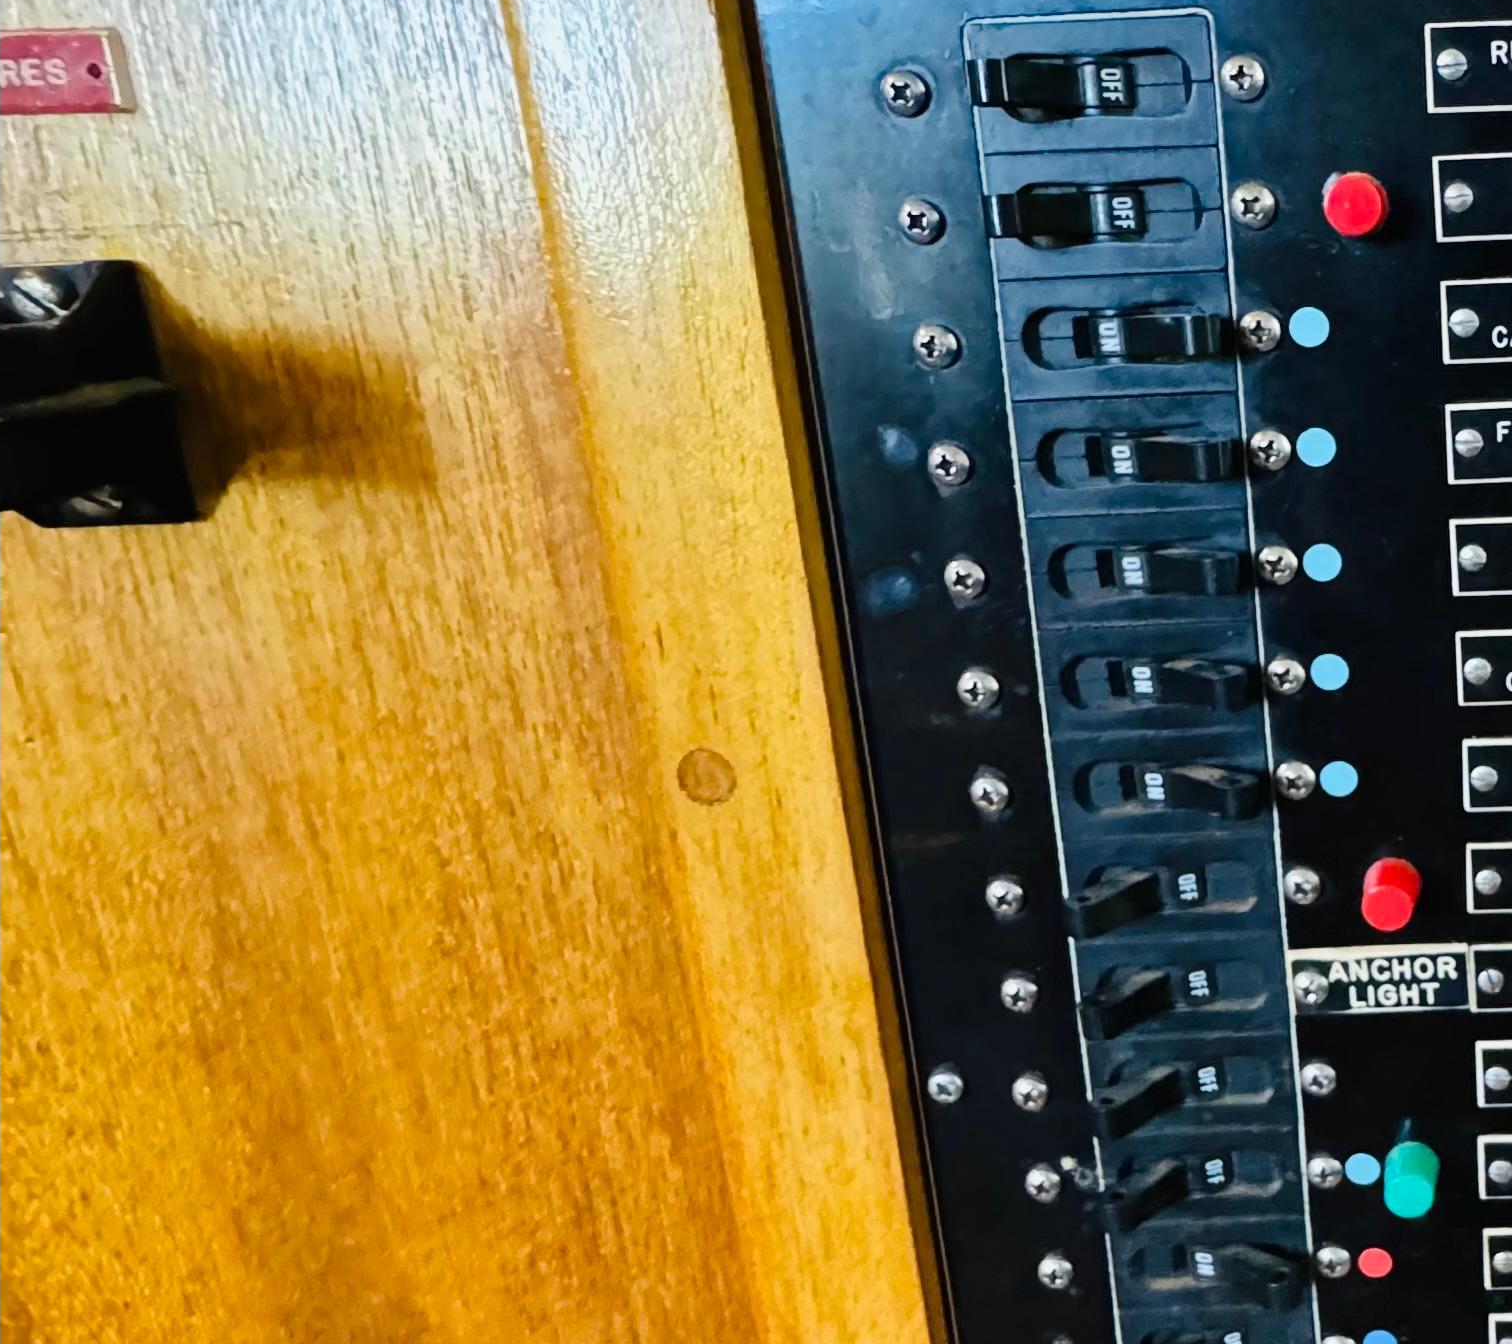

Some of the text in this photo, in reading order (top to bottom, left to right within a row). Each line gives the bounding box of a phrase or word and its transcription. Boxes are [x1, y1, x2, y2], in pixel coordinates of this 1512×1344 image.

[1099, 67, 1123, 103] OFF
[1111, 196, 1136, 231] OFF
[1098, 323, 1121, 354] ON
[1110, 444, 1134, 475] ON
[1122, 557, 1144, 586] ON
[1131, 666, 1154, 695] ON
[1143, 772, 1166, 802] ON
[1177, 873, 1199, 902] OFF
[1188, 969, 1210, 998] OFF
[1327, 955, 1459, 983] ANCHOR
[1348, 982, 1440, 1009] LIGHT
[1197, 1065, 1219, 1094] OFF
